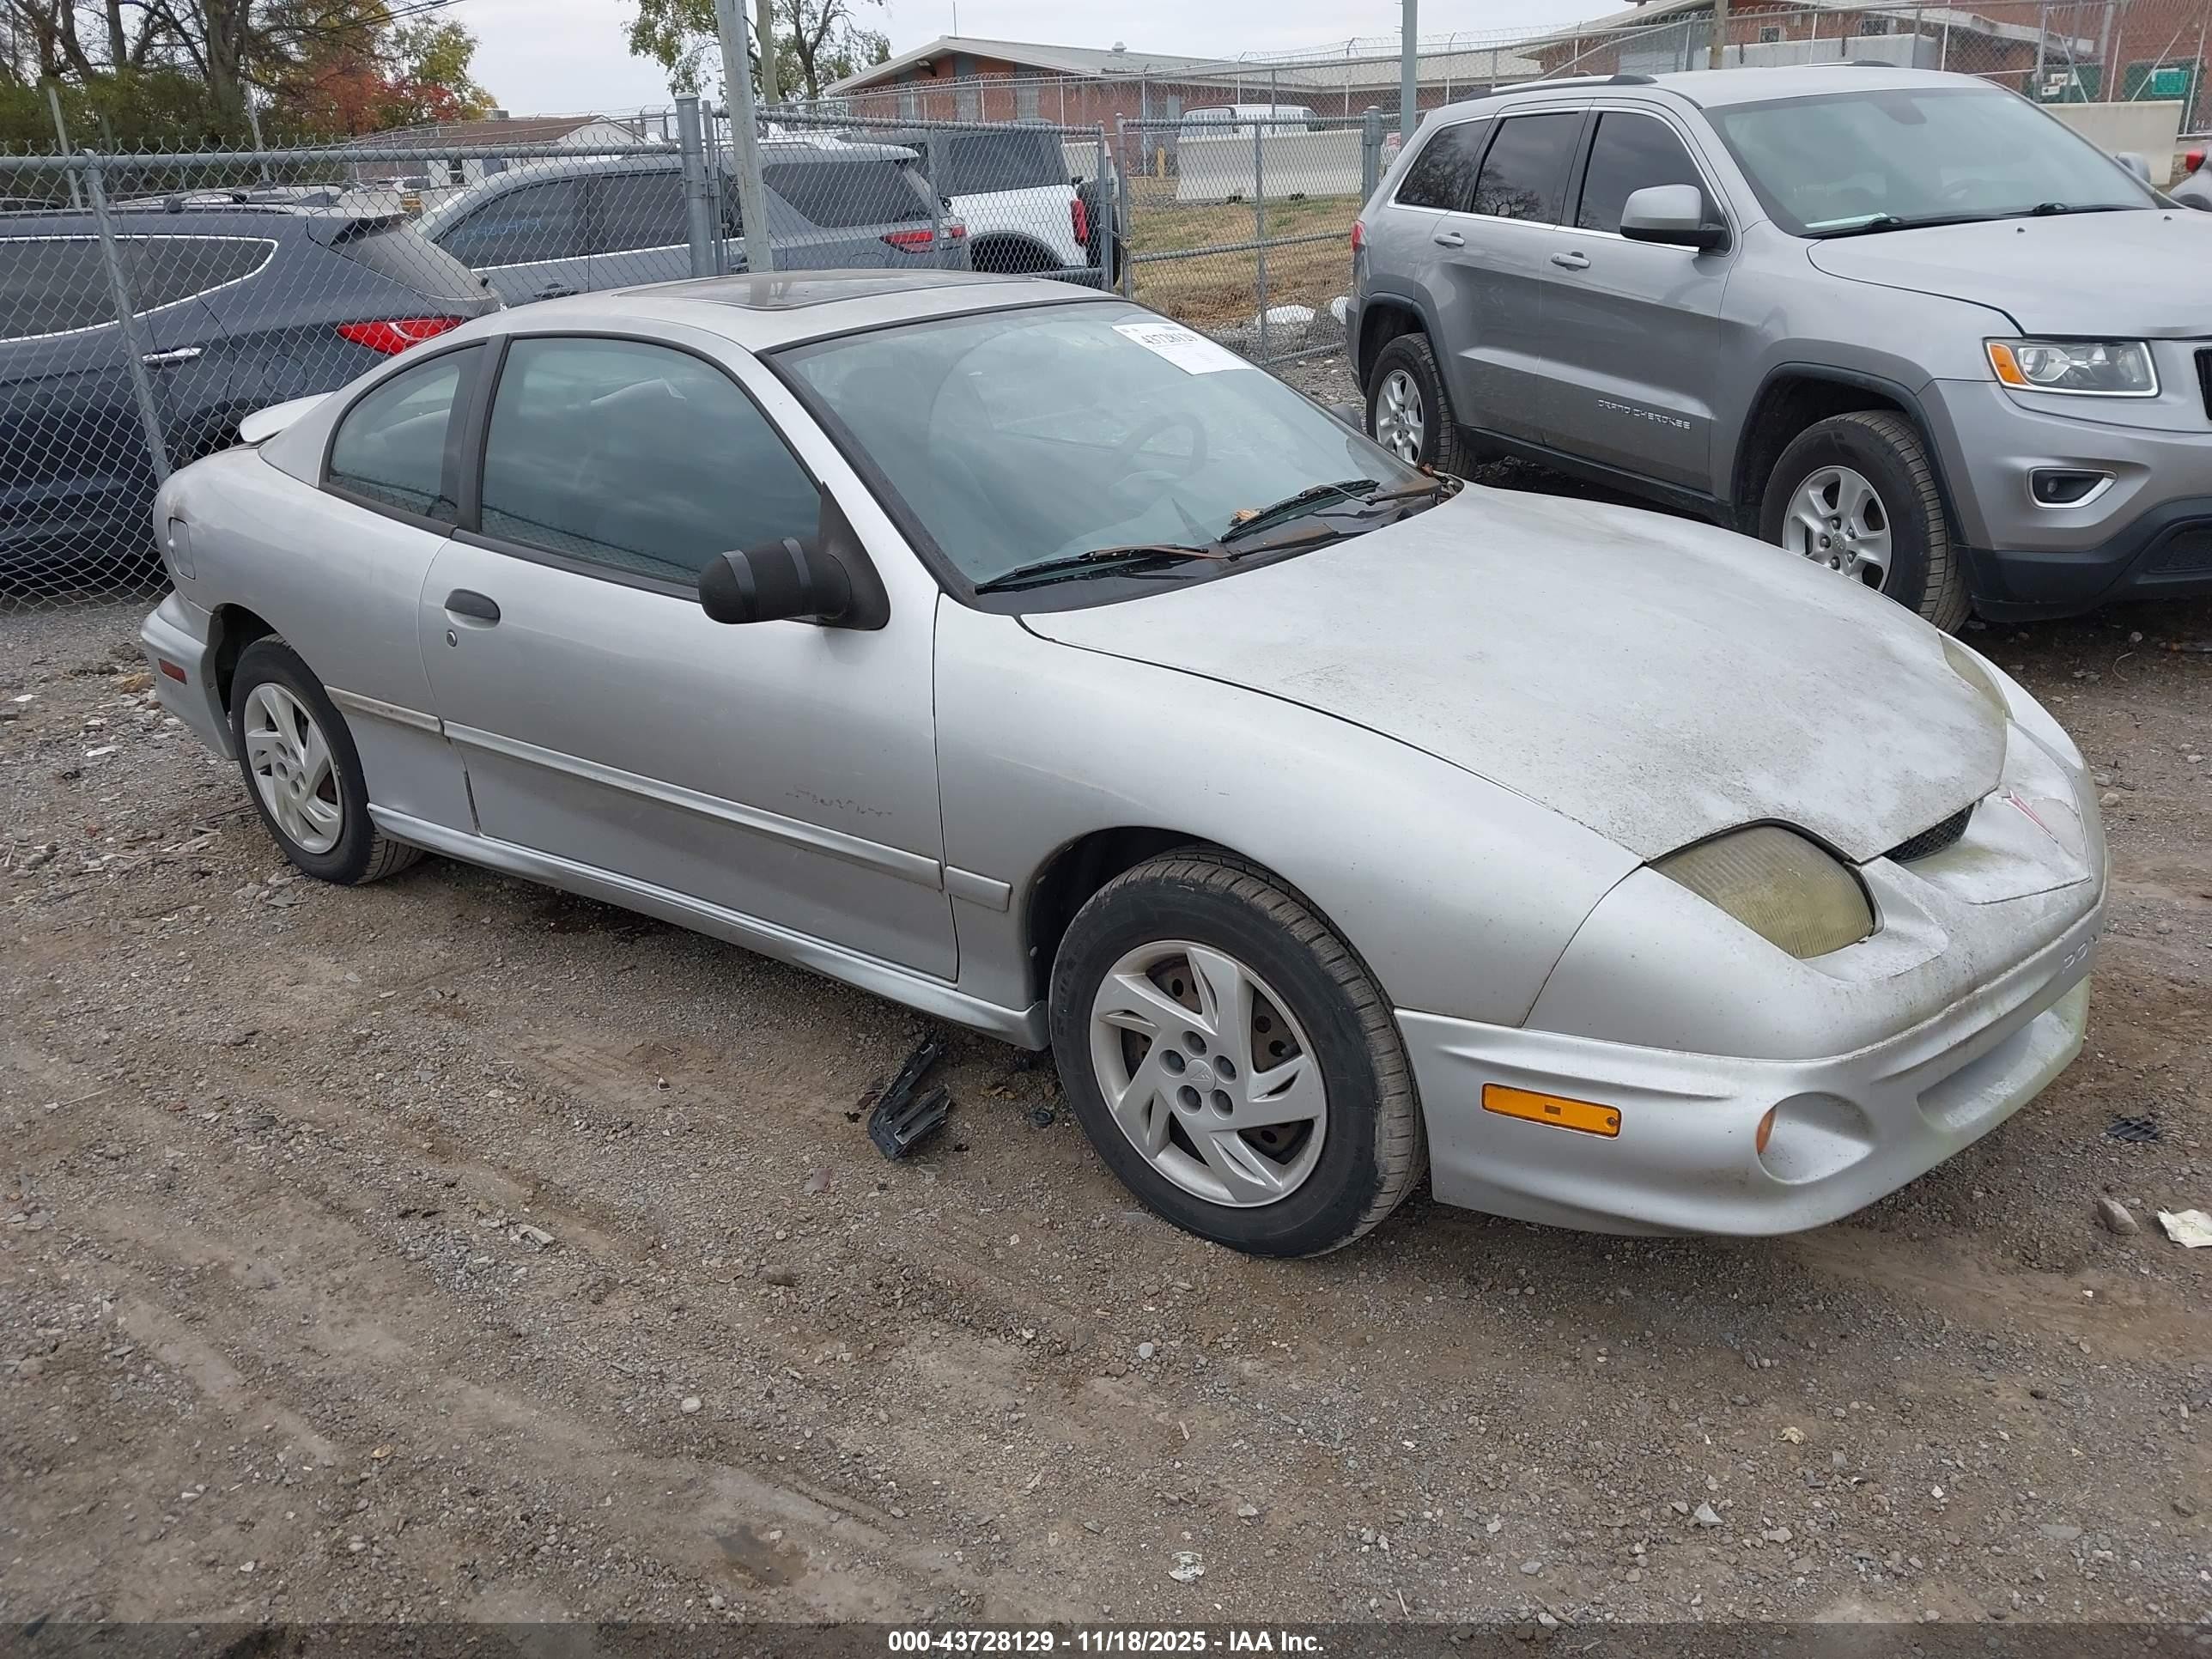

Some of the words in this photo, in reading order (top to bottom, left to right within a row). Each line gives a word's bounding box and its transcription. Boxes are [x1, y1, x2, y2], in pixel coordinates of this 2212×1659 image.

[1139, 333, 1198, 345] 43728129
[1597, 399, 1631, 414] GRAND
[1633, 409, 1691, 429] CHEROKEE
